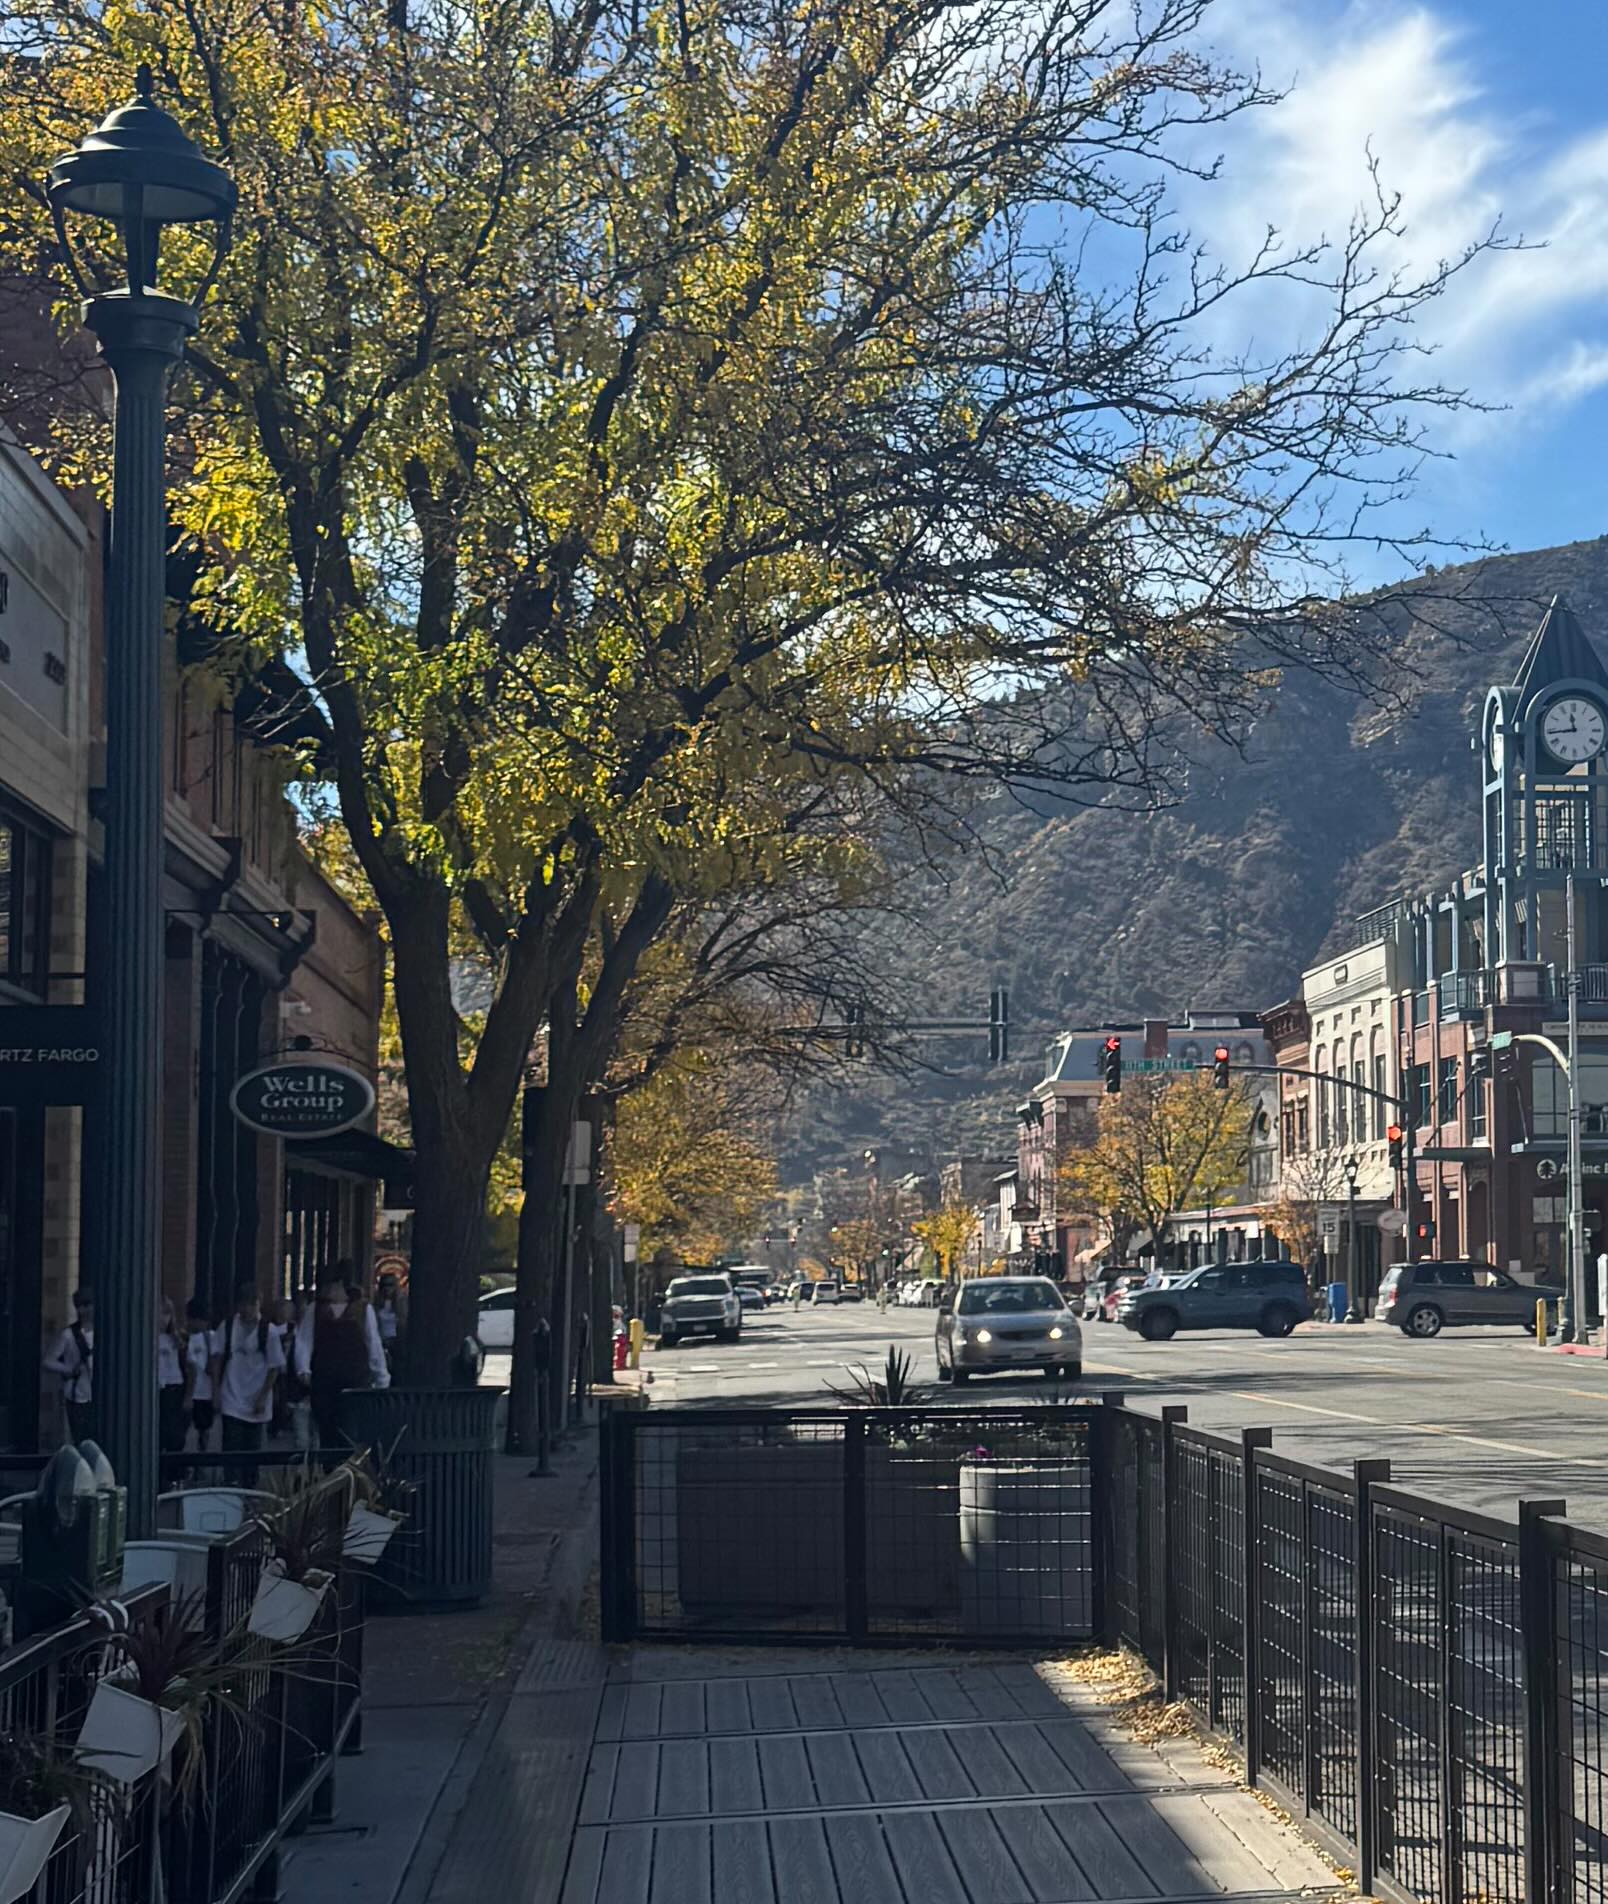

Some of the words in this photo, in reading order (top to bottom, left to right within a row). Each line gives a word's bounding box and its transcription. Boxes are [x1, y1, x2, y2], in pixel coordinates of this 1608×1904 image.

[38, 1048, 99, 1062] FARGO
[263, 1075, 345, 1093] Wells
[260, 1093, 344, 1113] Group
[1323, 1222, 1337, 1233] 15
